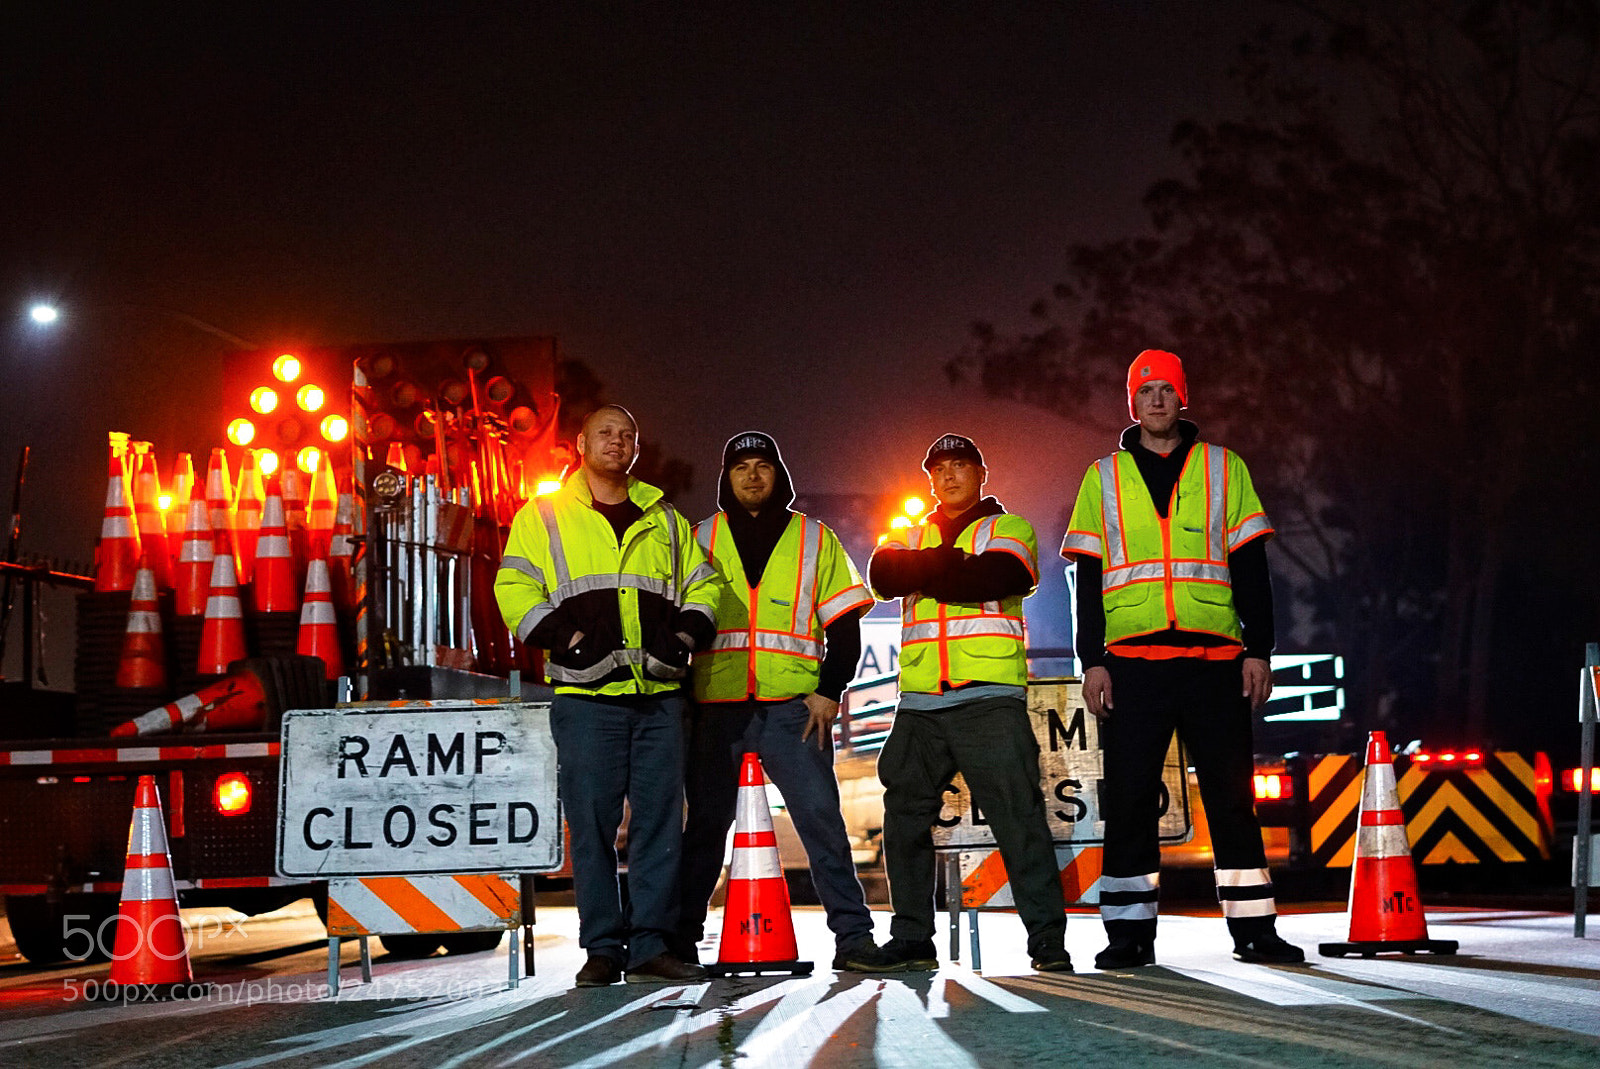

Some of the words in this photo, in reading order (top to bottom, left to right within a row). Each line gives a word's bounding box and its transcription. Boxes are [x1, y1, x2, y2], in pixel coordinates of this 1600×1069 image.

[337, 731, 507, 778] RAMP
[303, 801, 540, 851] CLOSED
[740, 912, 773, 936] MTC
